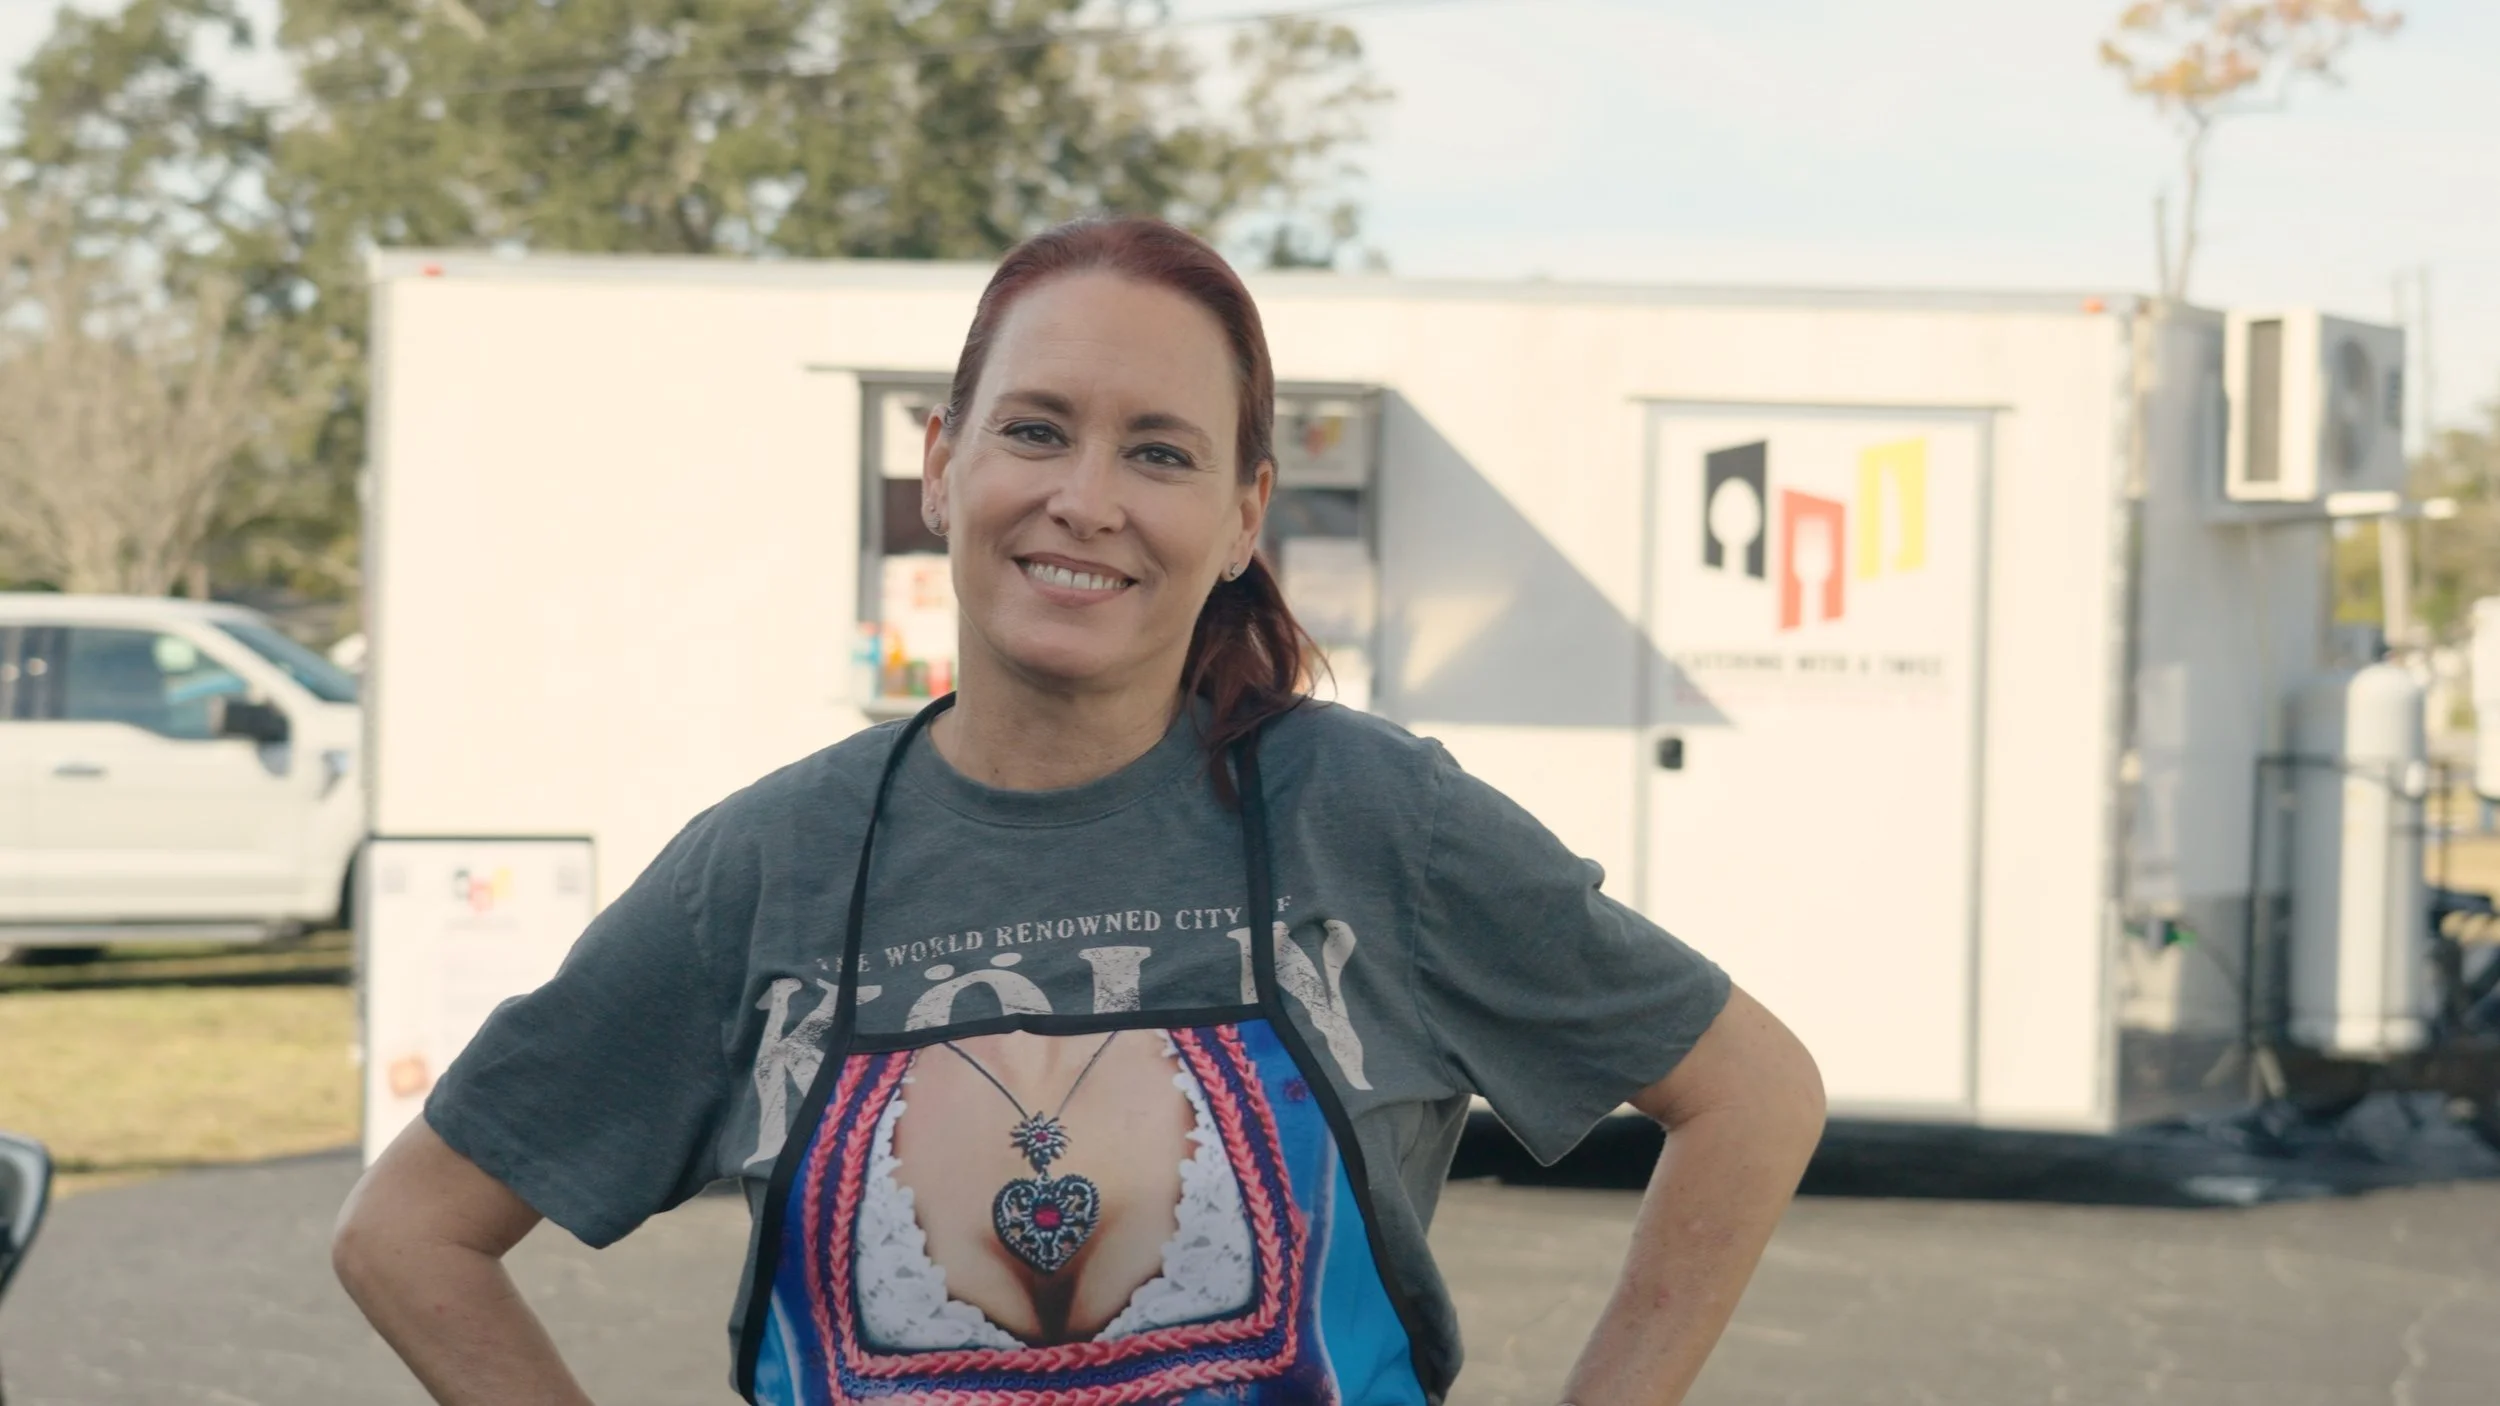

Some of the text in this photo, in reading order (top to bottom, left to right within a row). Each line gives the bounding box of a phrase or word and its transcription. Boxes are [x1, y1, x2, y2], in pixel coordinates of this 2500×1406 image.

[884, 931, 984, 968] WORLD
[996, 910, 1161, 947] RENOWNED
[1175, 907, 1242, 930] CITY
